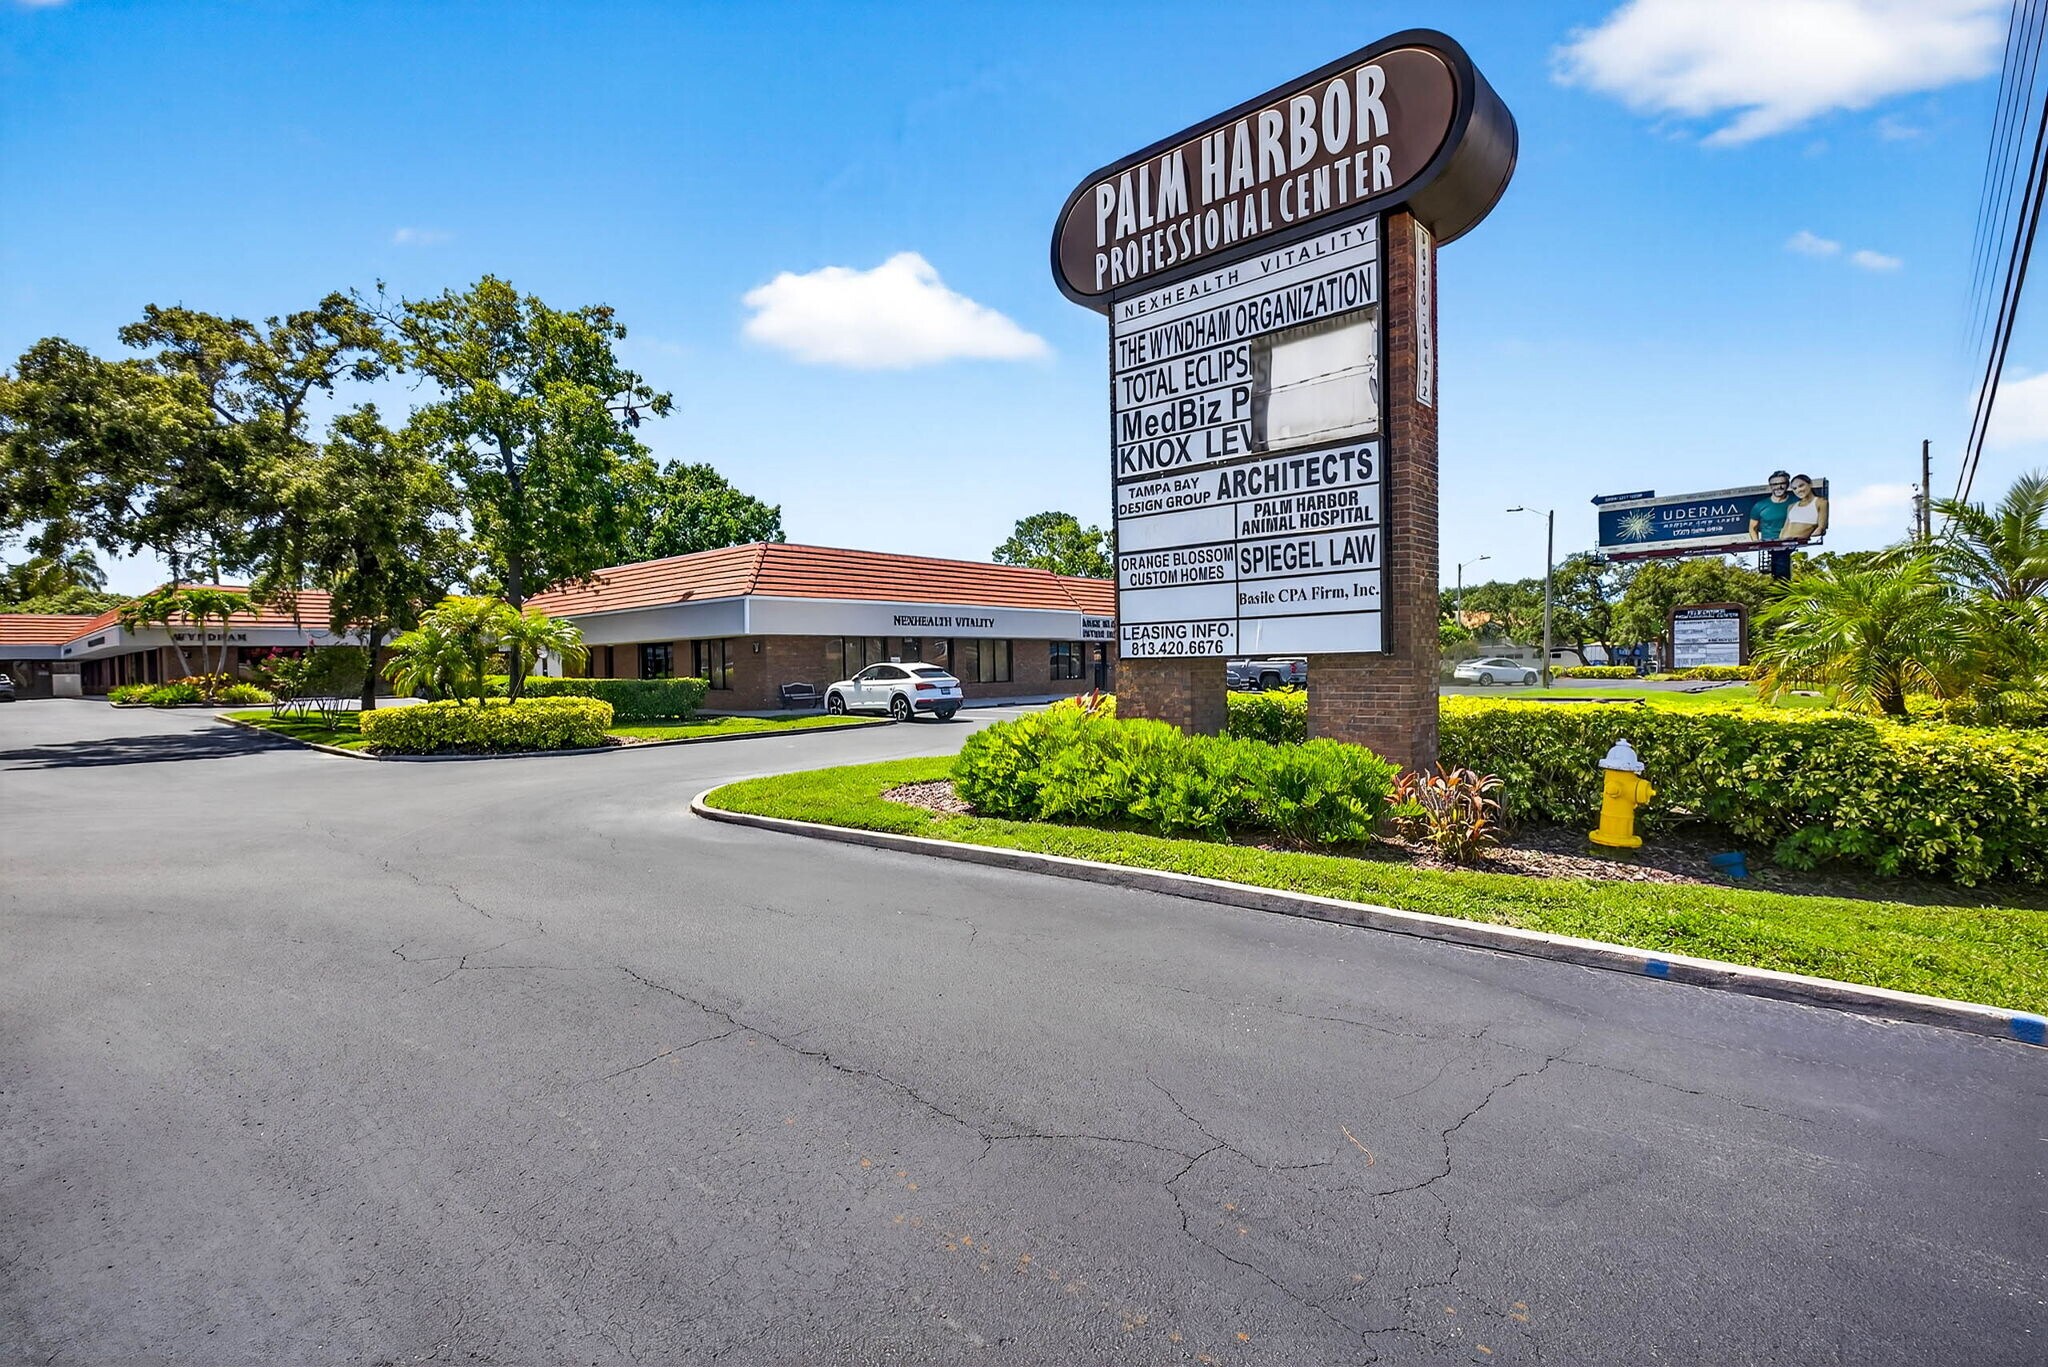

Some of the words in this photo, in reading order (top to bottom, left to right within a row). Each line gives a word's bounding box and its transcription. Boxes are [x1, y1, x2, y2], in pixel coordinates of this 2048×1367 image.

[1096, 149, 1189, 248] PALM
[1202, 64, 1390, 206] HARBOR
[1096, 187, 1273, 291] PROFESSIONAL
[1279, 145, 1394, 222] CENTER
[1125, 270, 1240, 318] NEXHEALTH
[1261, 225, 1369, 274] VITALITY
[1119, 336, 1146, 368] THE
[1150, 308, 1231, 360] WYNDHAM
[1236, 267, 1372, 337] ORGANIZATION
[1122, 365, 1179, 405] TOTAL
[1185, 344, 1252, 391] ECLIPS
[1122, 395, 1222, 442] MedBiz
[1120, 435, 1192, 474] KNOX
[1128, 482, 1171, 499] TAMPA
[1174, 477, 1200, 492] BAY
[1217, 448, 1373, 500] ARCHITECTS
[1119, 499, 1163, 515] DESIGN
[1166, 491, 1211, 508] GROUP
[1254, 499, 1292, 518] PALM
[1296, 490, 1359, 512] HARBOR
[1663, 503, 1739, 521] UDERMA
[1241, 515, 1297, 536] ANIMAL
[1300, 506, 1374, 528] HOSPITAL
[1121, 554, 1170, 572] ORANGE
[1173, 547, 1234, 566] BLOSSOM
[1240, 541, 1324, 574] SPIEGEL
[1329, 534, 1376, 566] LAW
[1130, 569, 1178, 586] CUSTOM
[1181, 565, 1225, 582] HOMES
[1239, 591, 1275, 606] Basile
[1278, 588, 1307, 602] CPA
[1311, 586, 1349, 601] Firm,
[1353, 583, 1380, 597] Inc.
[893, 615, 952, 627] NEXHEALTH
[955, 617, 995, 628] VITALITY
[1122, 625, 1187, 641] LEASING
[1192, 622, 1234, 639] INFO.
[1131, 640, 1224, 656] 813.420.6676
